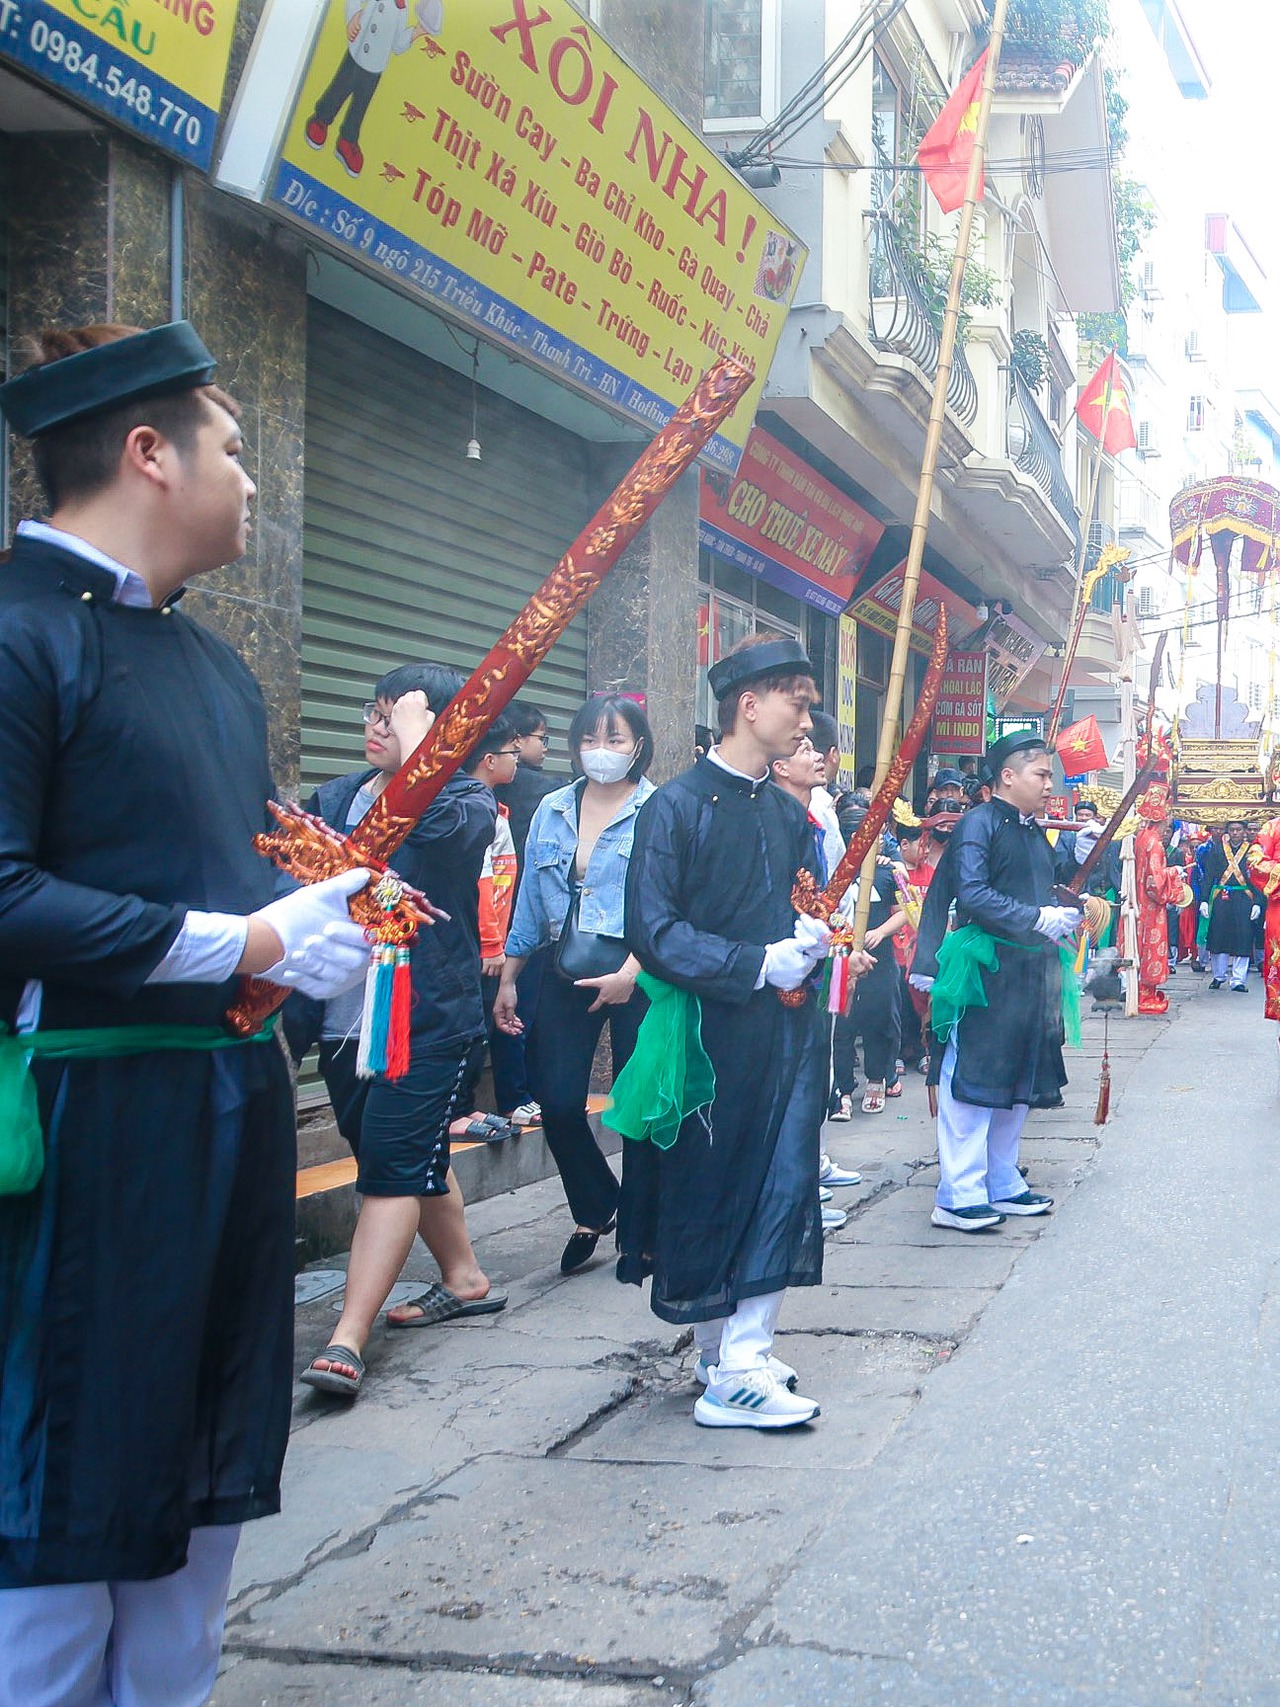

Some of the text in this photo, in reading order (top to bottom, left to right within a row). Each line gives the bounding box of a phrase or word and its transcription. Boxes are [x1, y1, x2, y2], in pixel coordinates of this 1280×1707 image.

[30, 20, 201, 146] 0984.548.770
[490, 0, 619, 134] XÔI
[625, 106, 727, 246] NHA
[412, 167, 462, 229] Tóp
[465, 207, 508, 255] Mỡ
[526, 250, 578, 305] Pate
[596, 298, 650, 358] Trứng
[663, 347, 694, 385] Lạp
[432, 107, 482, 170] Thịt
[484, 150, 517, 197] Xá
[520, 179, 558, 228] Xíu
[574, 222, 606, 264] Giò
[608, 248, 633, 284] Bò
[647, 278, 688, 326] Ruốc
[700, 318, 728, 357] Xúc
[450, 50, 512, 124] Sườn
[515, 105, 558, 163] Cay
[574, 156, 601, 198] Ba
[603, 181, 636, 224] Chỉ
[634, 208, 665, 251] Kho
[678, 245, 699, 280] Gà
[700, 265, 736, 312] Quay
[745, 304, 771, 339] Chả
[332, 208, 364, 240] Số
[360, 227, 375, 249] 9
[374, 240, 410, 270] ngõ
[409, 258, 442, 289] 215
[440, 274, 484, 317] Triều
[531, 329, 571, 369] Thanh
[598, 372, 622, 397] HN
[727, 479, 768, 528] CHO
[761, 498, 808, 552] THUÊ
[796, 524, 824, 562] XE
[813, 536, 850, 577] MÁY
[953, 721, 980, 737] INDO
